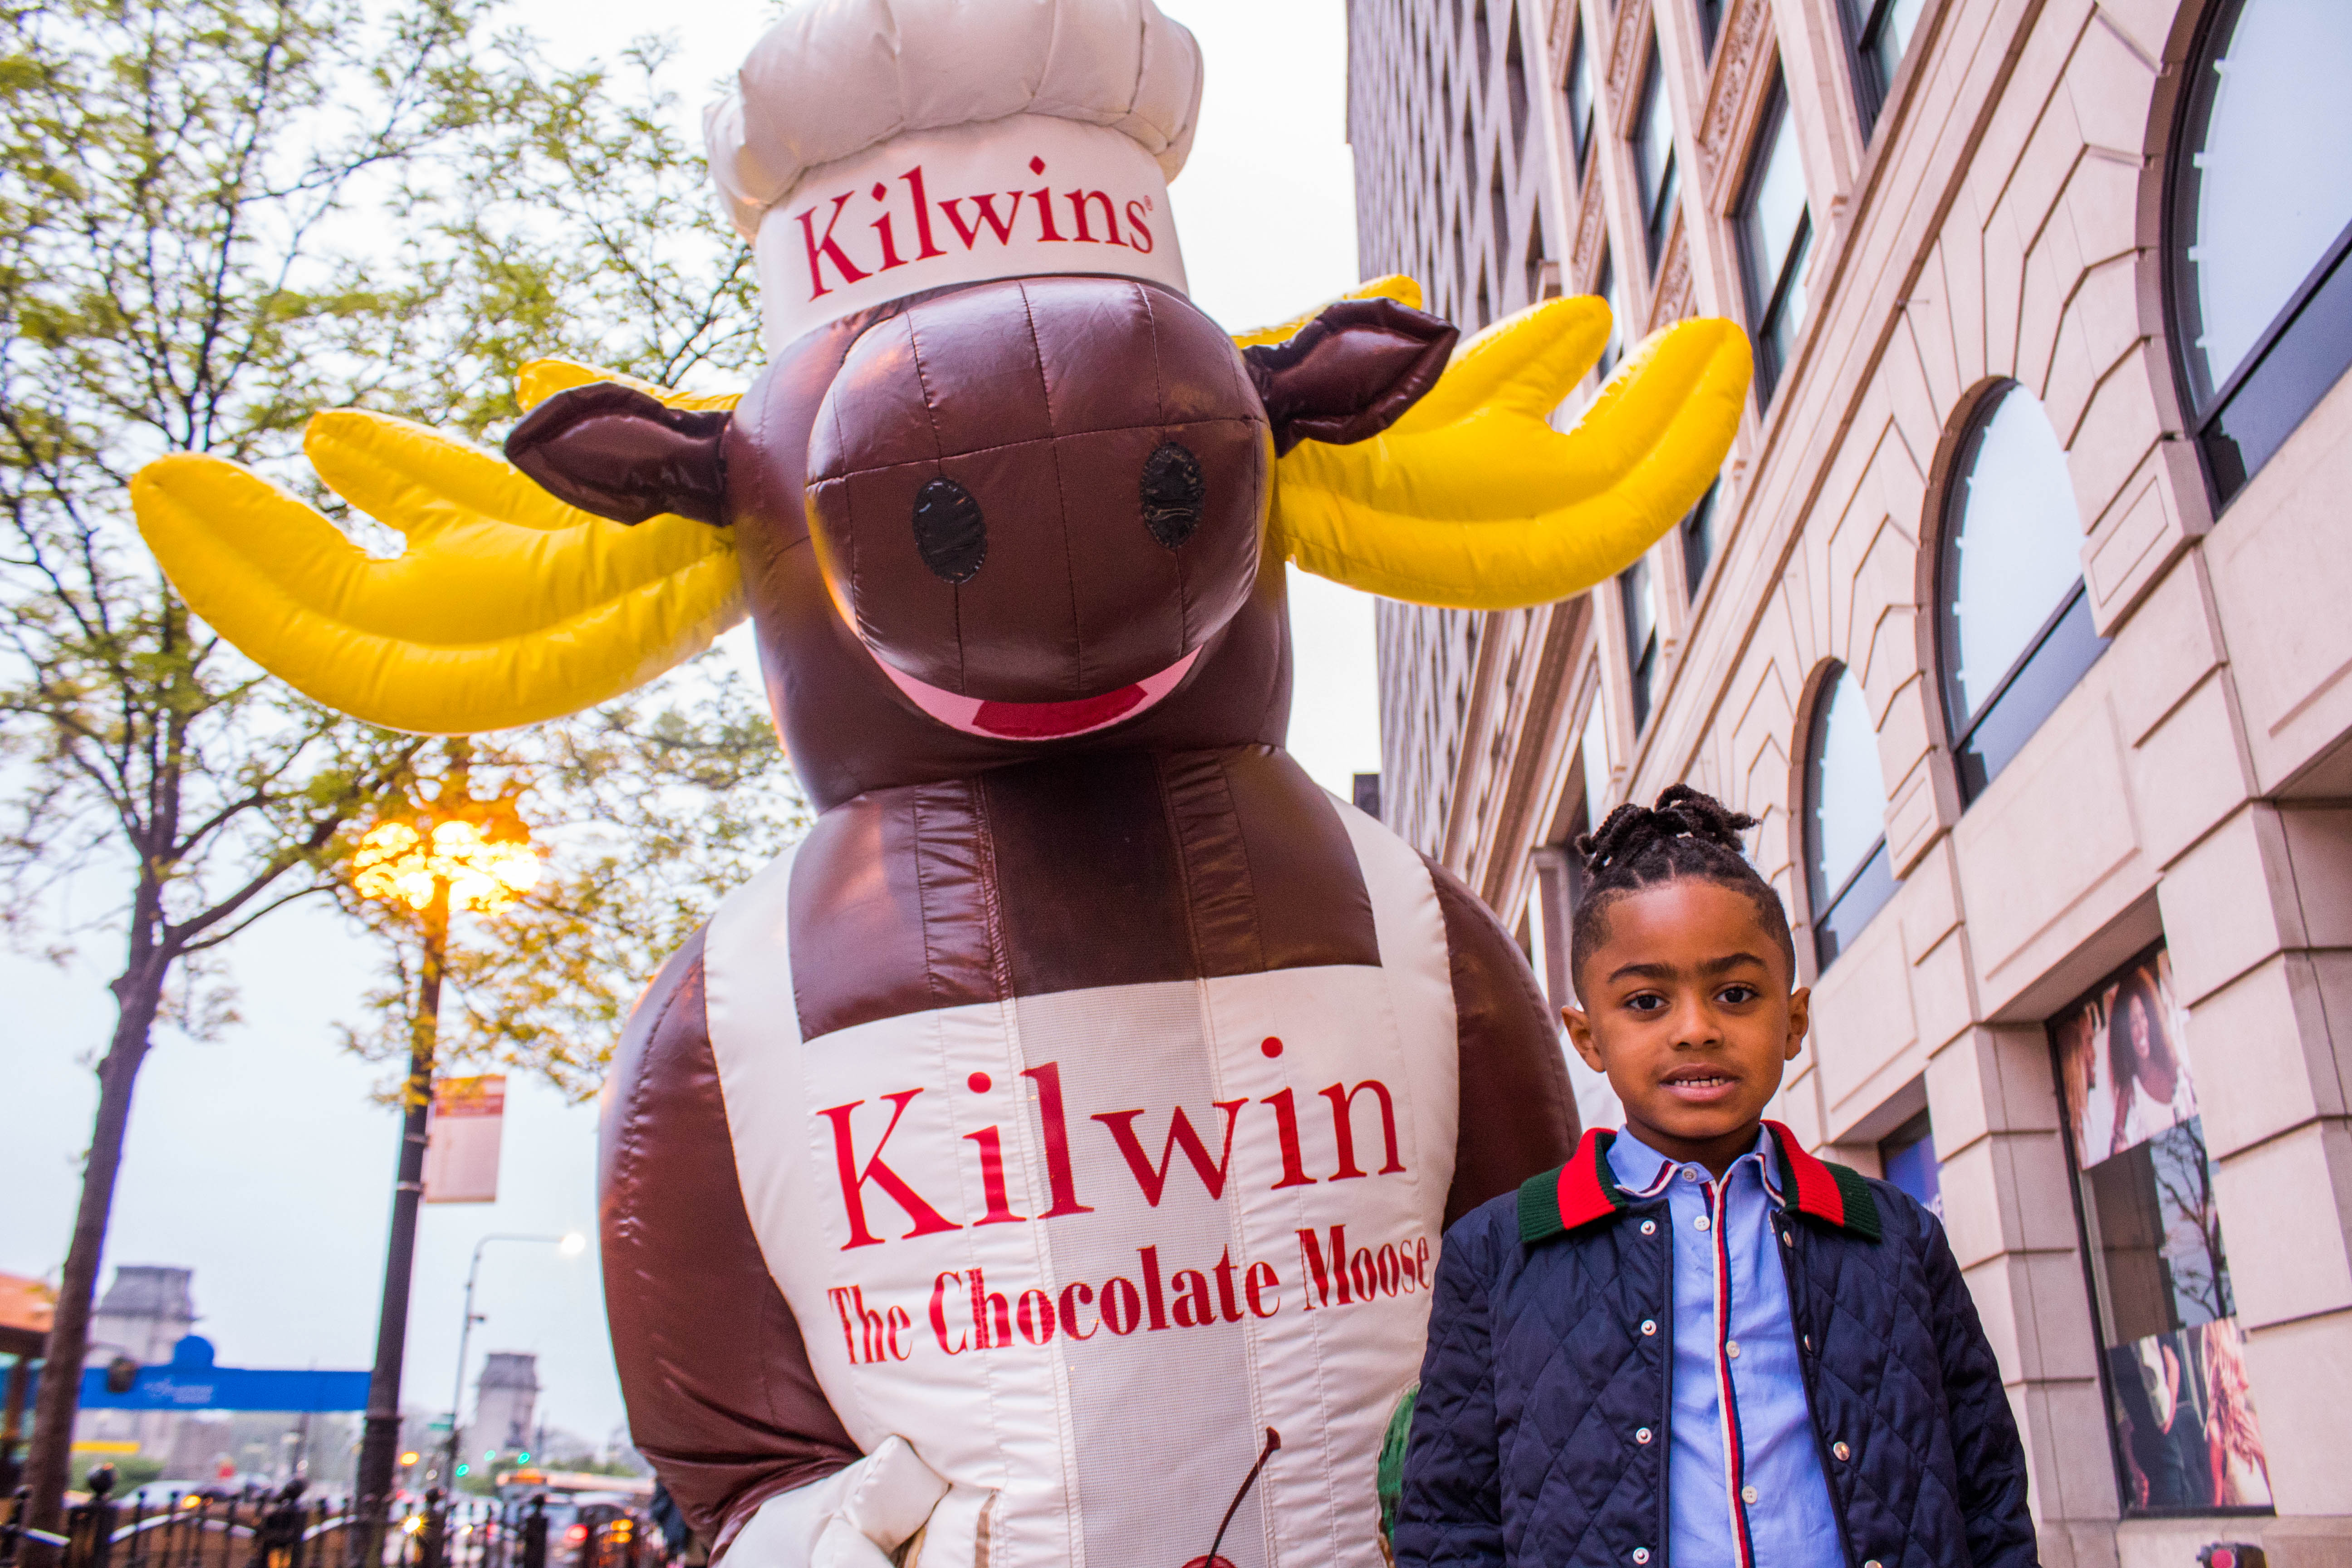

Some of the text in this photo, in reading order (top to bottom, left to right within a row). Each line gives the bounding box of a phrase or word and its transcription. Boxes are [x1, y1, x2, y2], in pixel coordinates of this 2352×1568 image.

[816, 1035, 1407, 1252] Kilwin
[827, 1224, 1431, 1365] The Chocolate Moose
